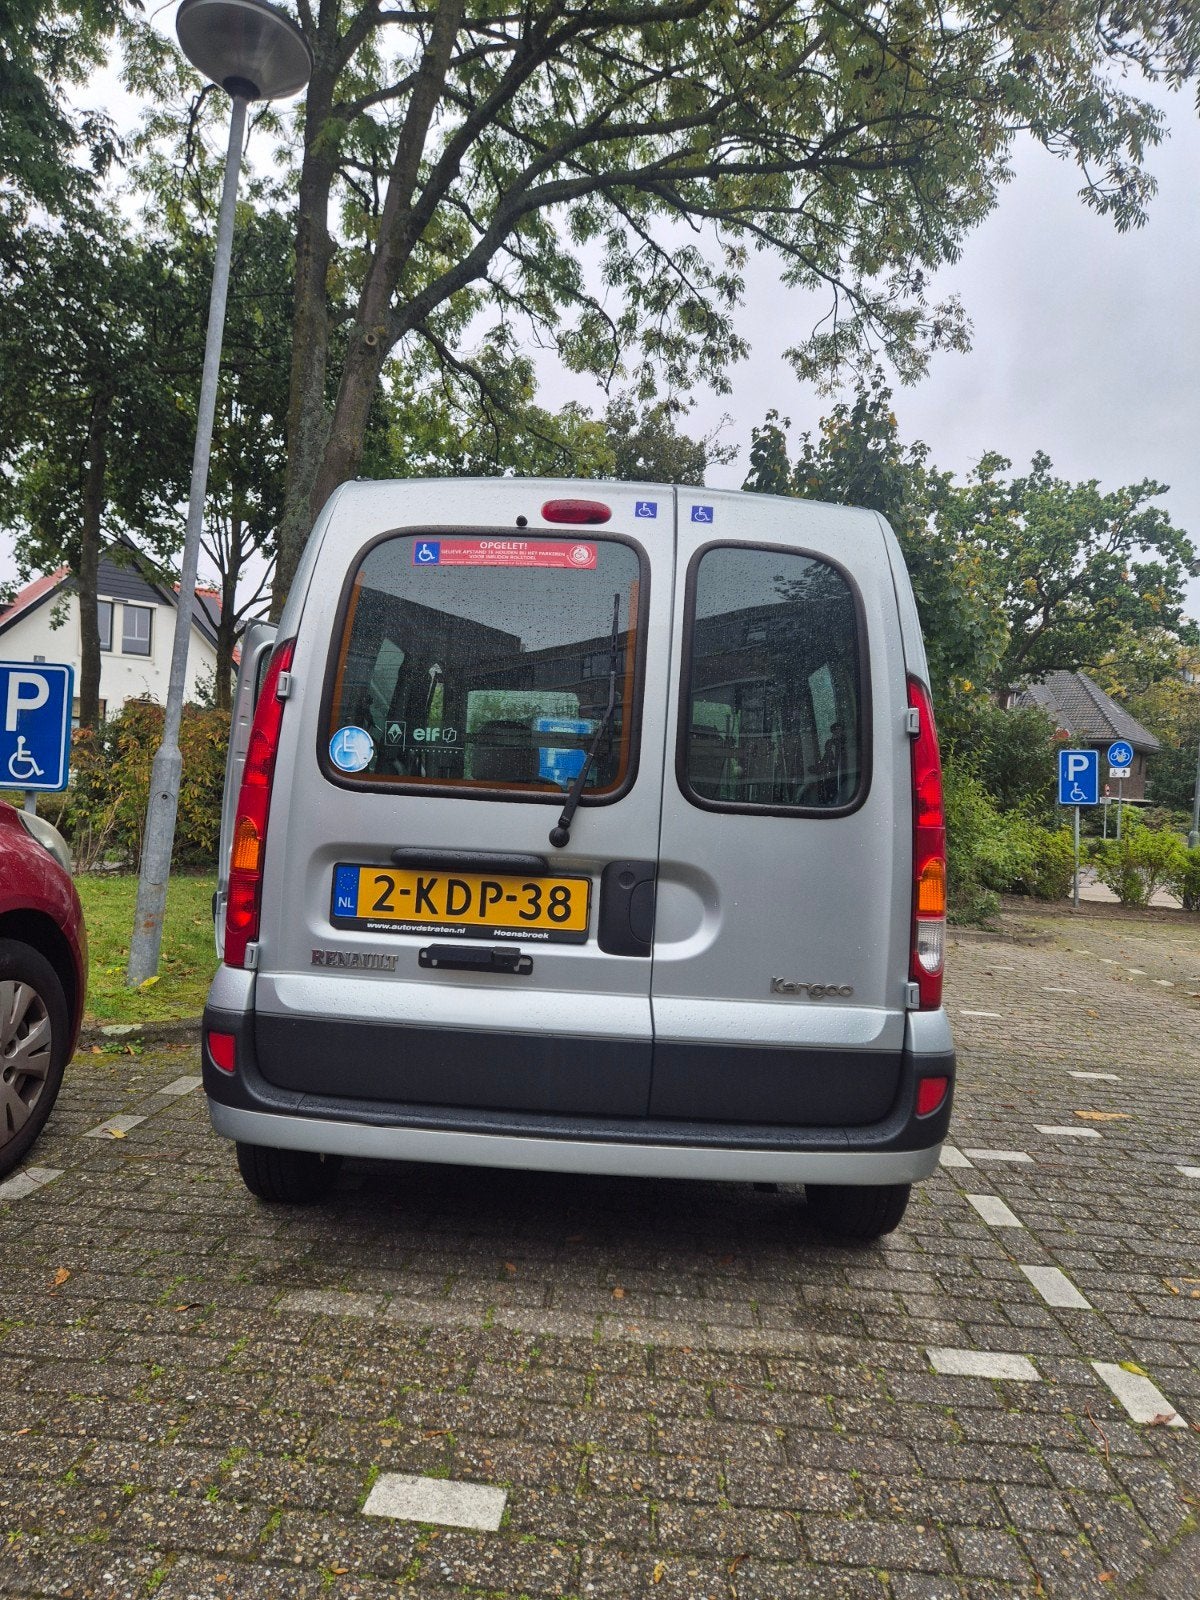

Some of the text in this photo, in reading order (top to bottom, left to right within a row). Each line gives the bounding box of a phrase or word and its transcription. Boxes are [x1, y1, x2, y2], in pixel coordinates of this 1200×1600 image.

[480, 541, 528, 550] OPGELET!
[5, 671, 50, 732] P
[413, 727, 440, 742] elf
[1068, 754, 1090, 782] P
[338, 896, 355, 909] NL
[372, 874, 572, 923] 2-KDP-38
[366, 922, 550, 940] www.autovdstraten.nl Hoensbroek
[311, 948, 399, 972] RENAULT
[770, 975, 854, 1001] Kangoo
